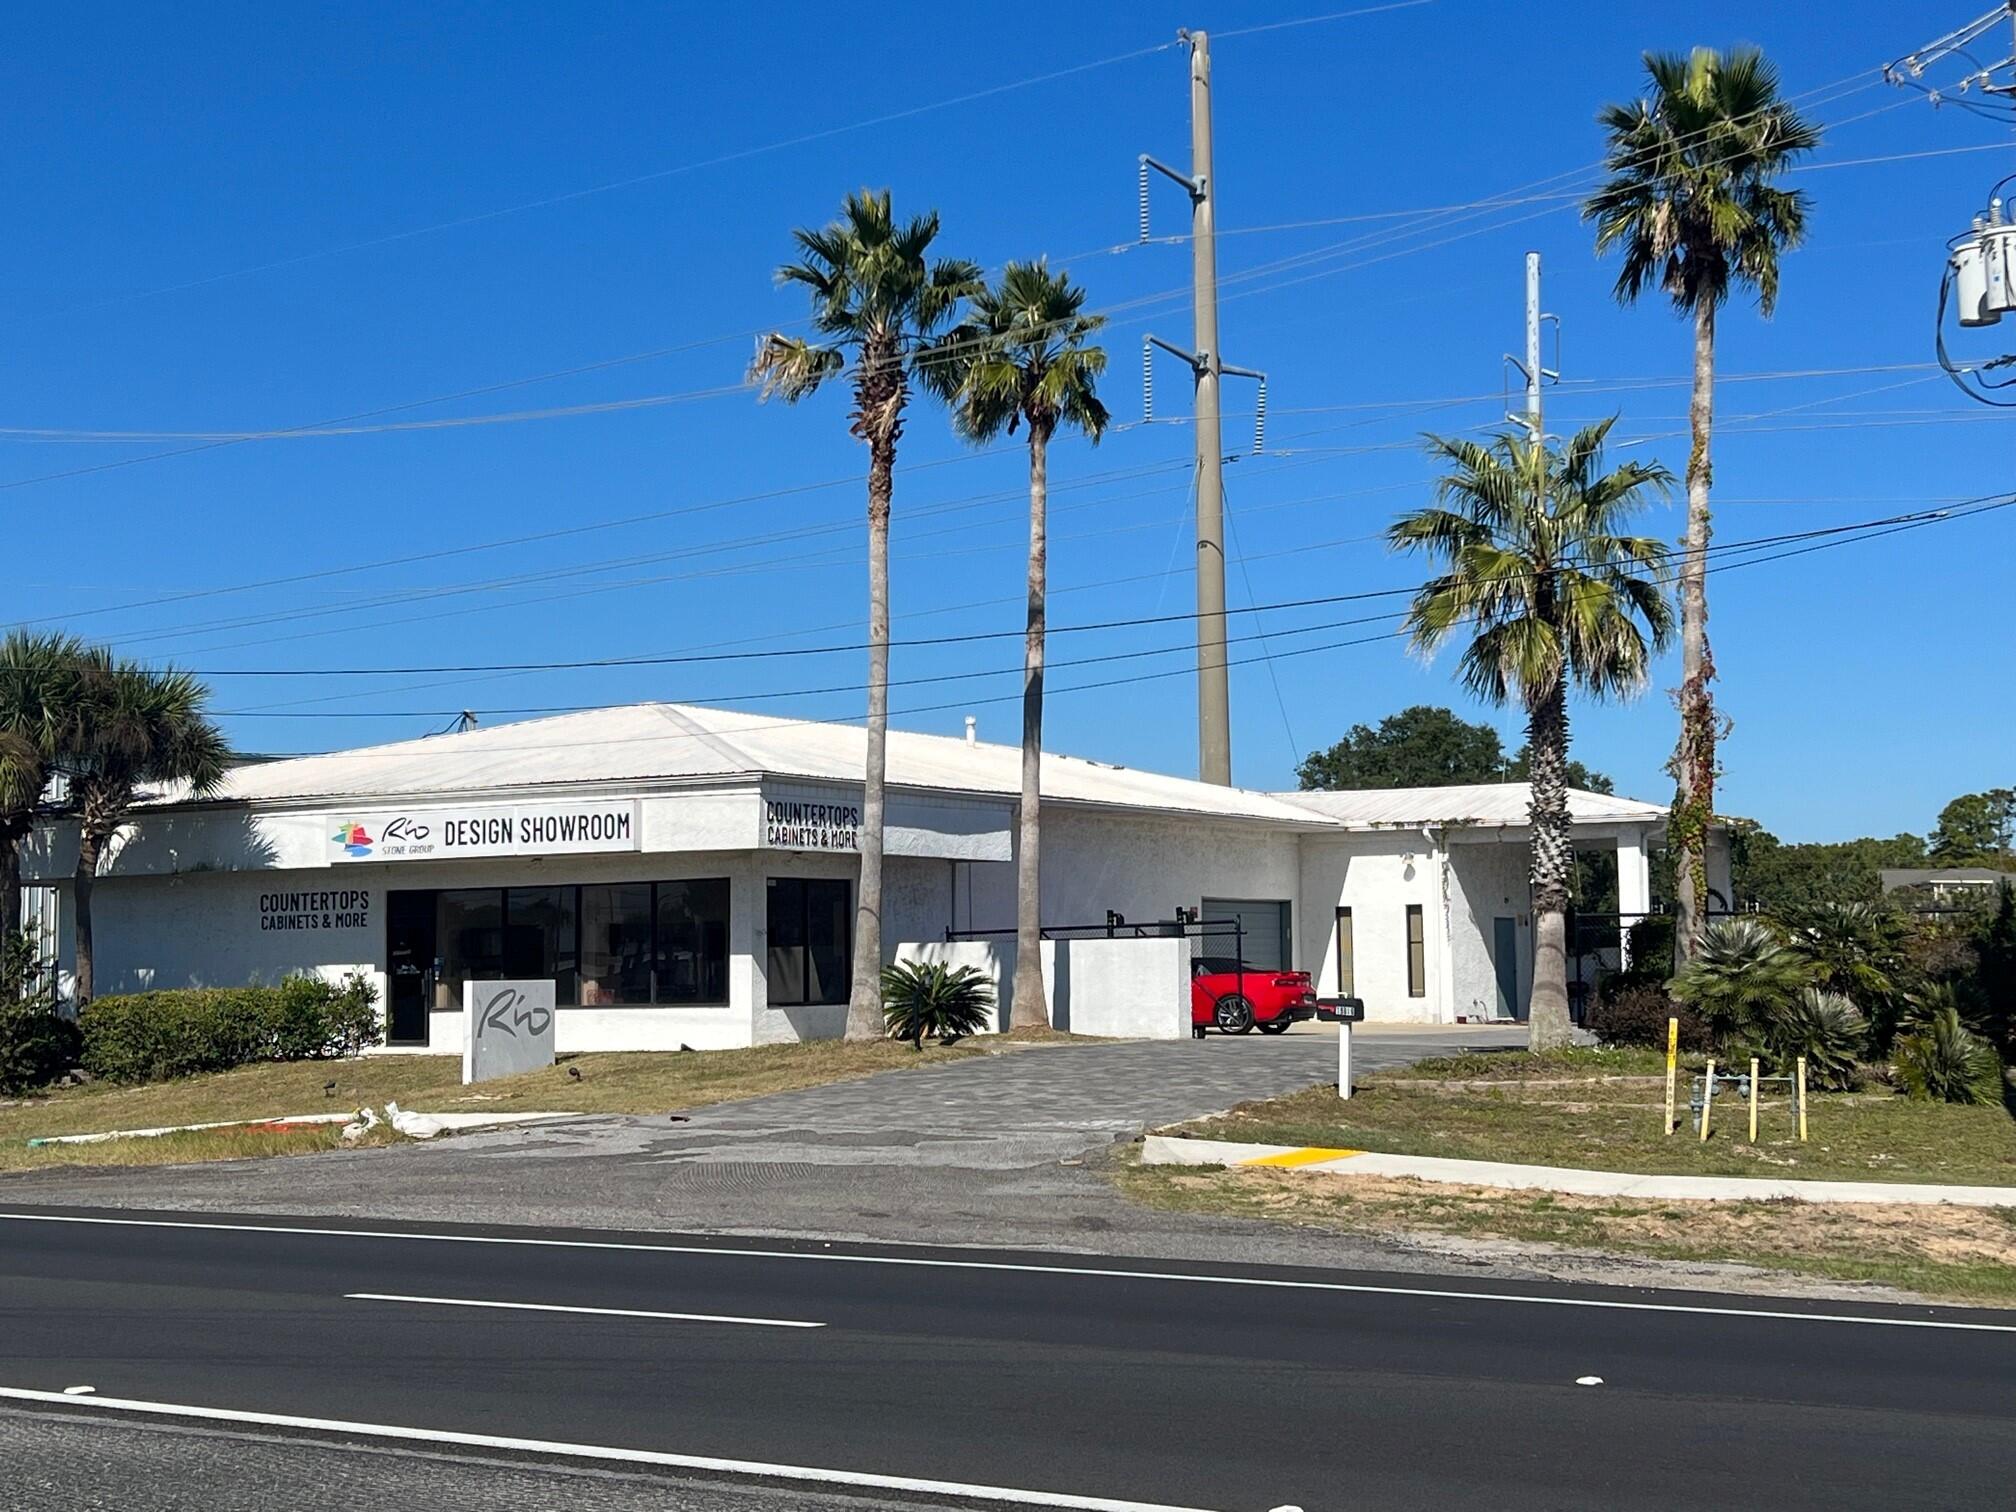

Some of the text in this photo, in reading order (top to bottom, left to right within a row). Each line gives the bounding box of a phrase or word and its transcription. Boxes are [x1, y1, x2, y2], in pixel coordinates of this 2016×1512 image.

[766, 801, 858, 828] COUNTERTOPS
[381, 817, 430, 842] Rio
[445, 812, 630, 846] DESIGN SHOWROOM
[767, 826, 858, 850] CABINETS & MORE
[382, 844, 435, 855] STONE GROUP
[260, 890, 369, 913] COUNTERTOPS
[261, 912, 368, 930] CABINETS & MORE
[477, 988, 551, 1038] Rio
